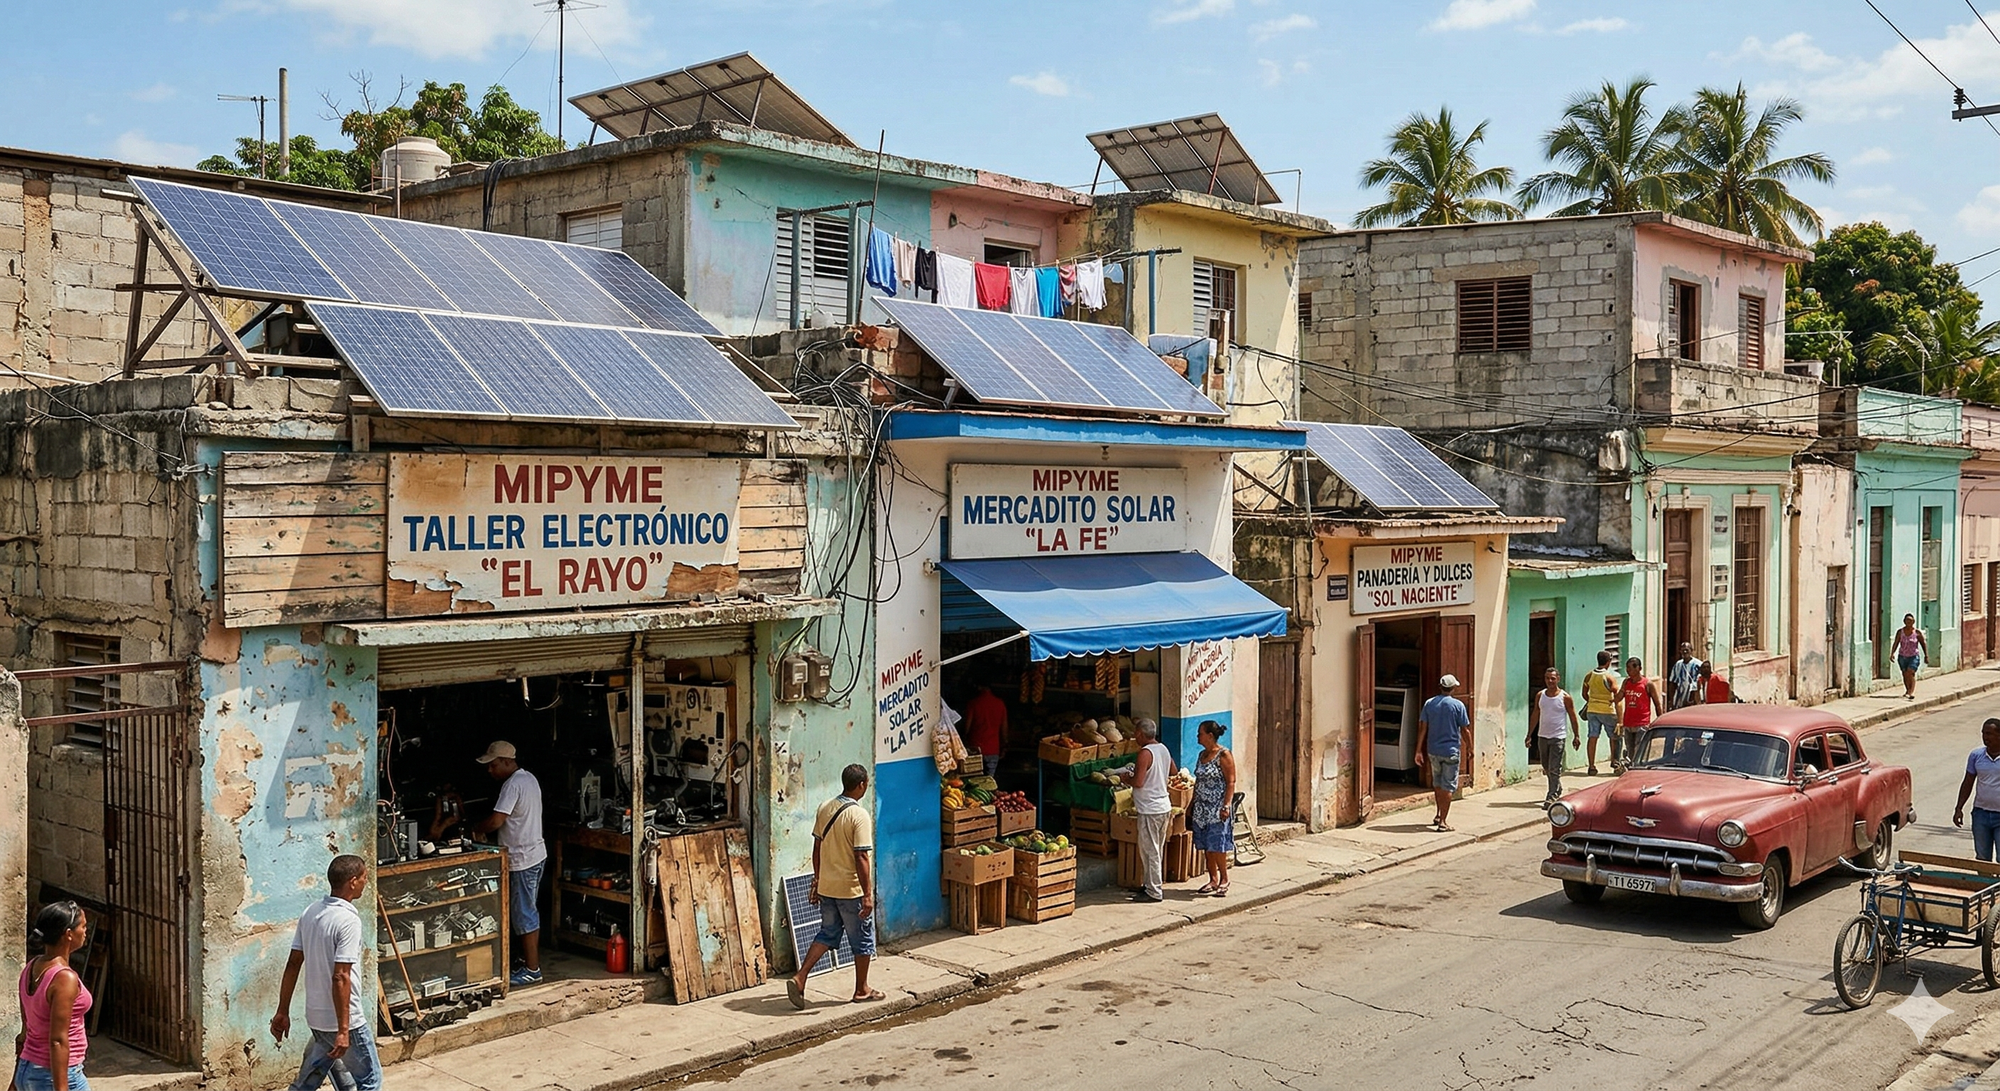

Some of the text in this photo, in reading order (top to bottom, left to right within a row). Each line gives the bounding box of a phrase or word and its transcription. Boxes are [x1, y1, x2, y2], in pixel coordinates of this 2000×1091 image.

[494, 464, 663, 504] MIPYME
[1033, 469, 1119, 491] MIPYME
[963, 495, 1176, 525] MERCADITO SOLAR
[402, 505, 729, 552] TALLER ELECTRÓNICO
[1025, 525, 1119, 552] “LA FE”
[1390, 546, 1443, 564] MIPYME
[481, 551, 663, 598] “EL RAYO”
[1357, 563, 1420, 588] PANADERÍA
[1423, 566, 1431, 582] Y
[1433, 563, 1473, 582] DULCES
[882, 649, 924, 690] MIPYME
[879, 672, 929, 717] MERCADITO
[889, 698, 922, 731] SOLAR
[884, 712, 929, 754] "LA FE"
